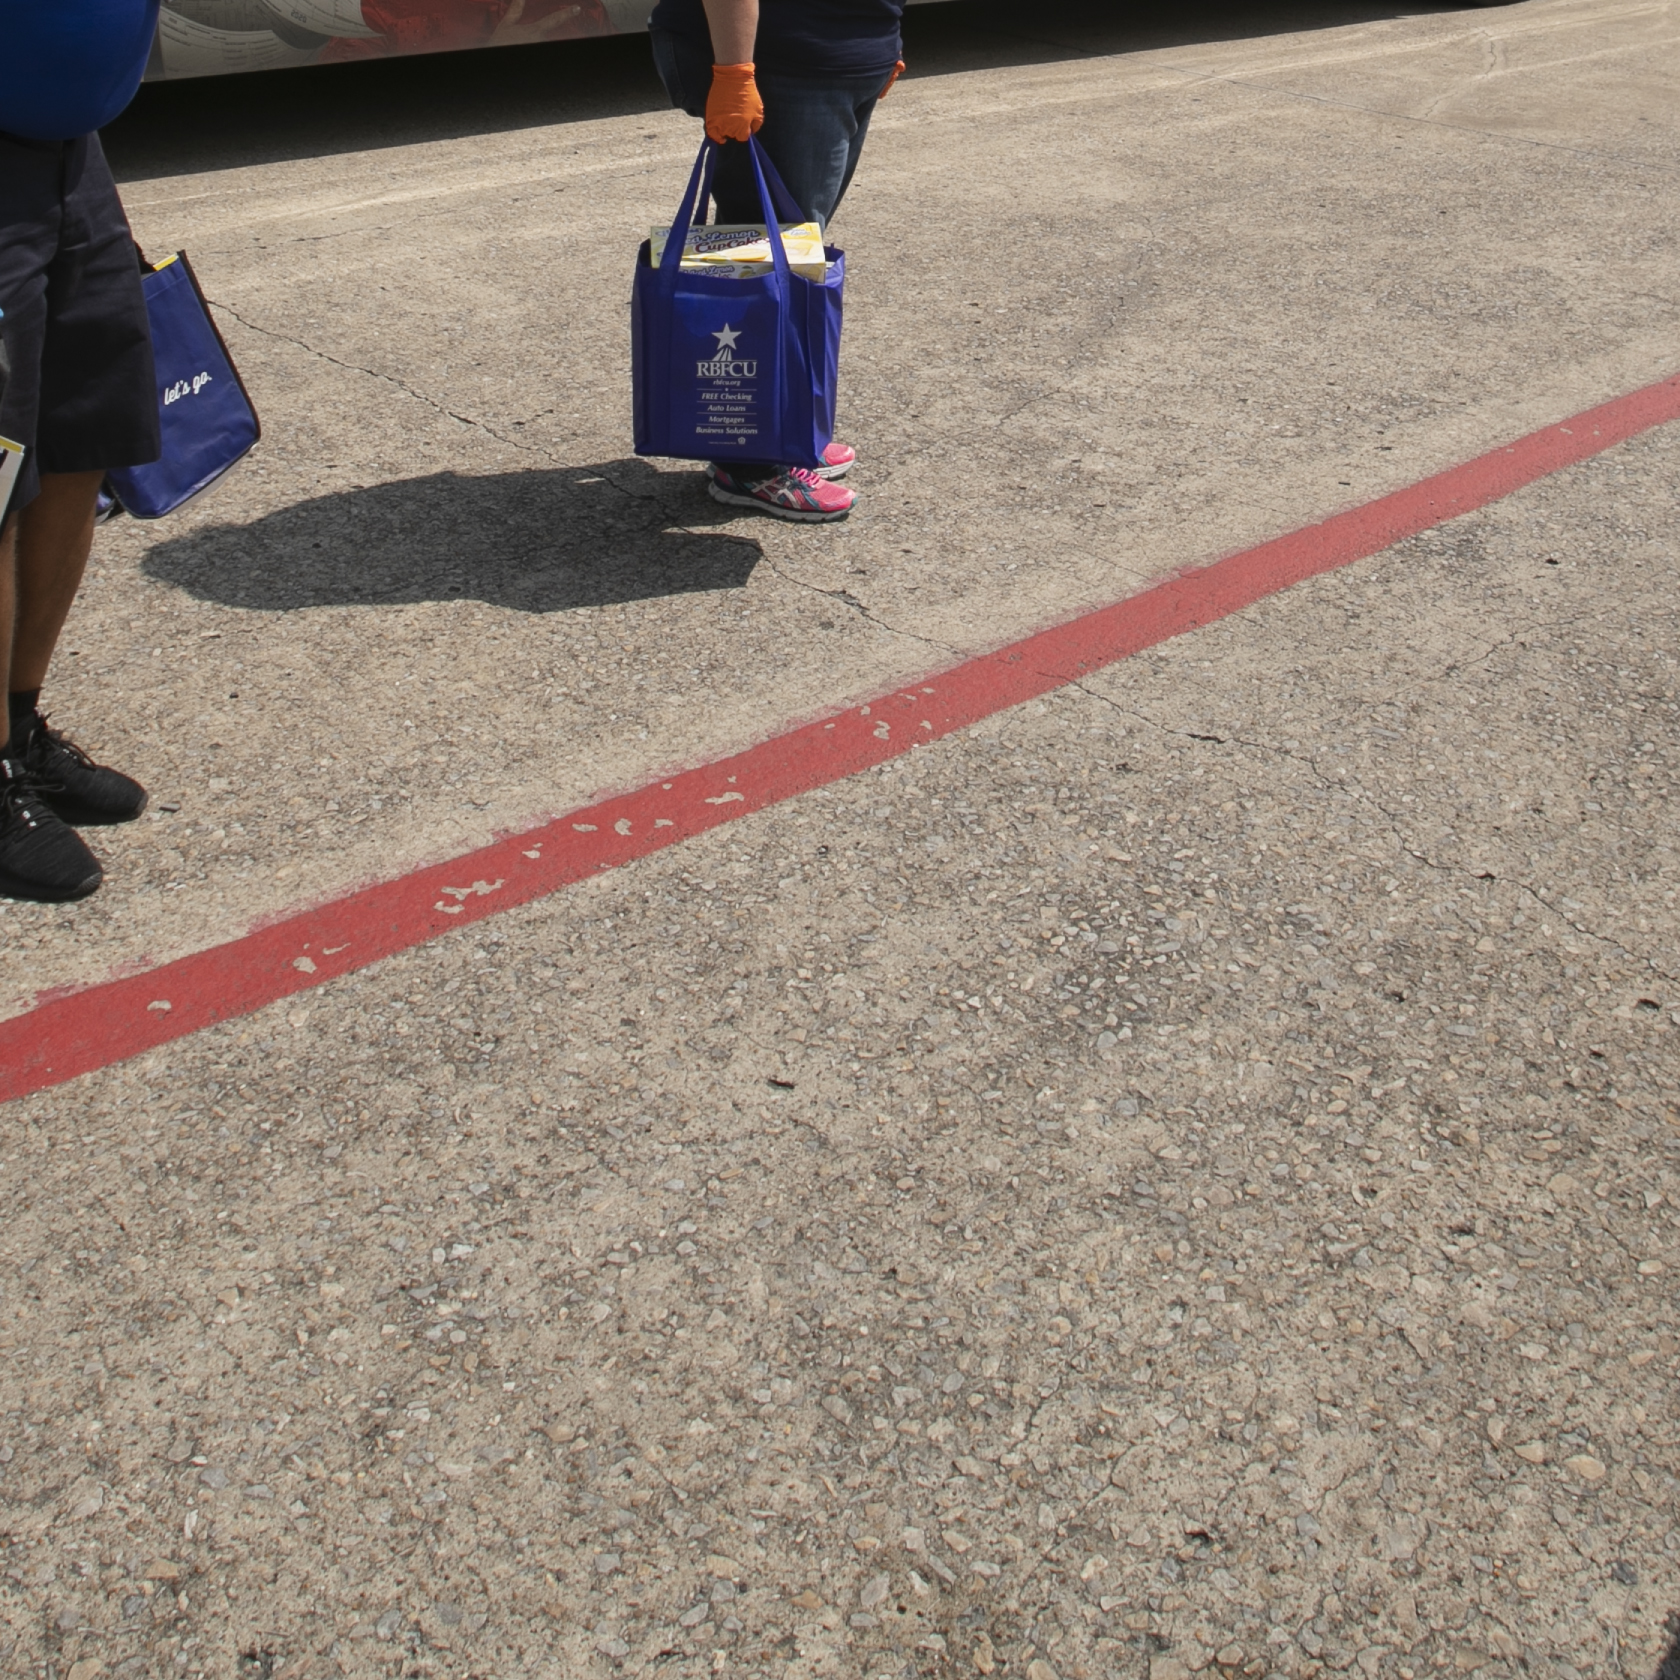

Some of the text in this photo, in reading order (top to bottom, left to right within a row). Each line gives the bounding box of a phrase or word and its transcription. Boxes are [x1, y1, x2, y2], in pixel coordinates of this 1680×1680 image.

[696, 361, 757, 377] RBFCU
[164, 371, 213, 405] let's go.
[720, 393, 752, 402] Checking
[708, 416, 745, 424] Mortgages
